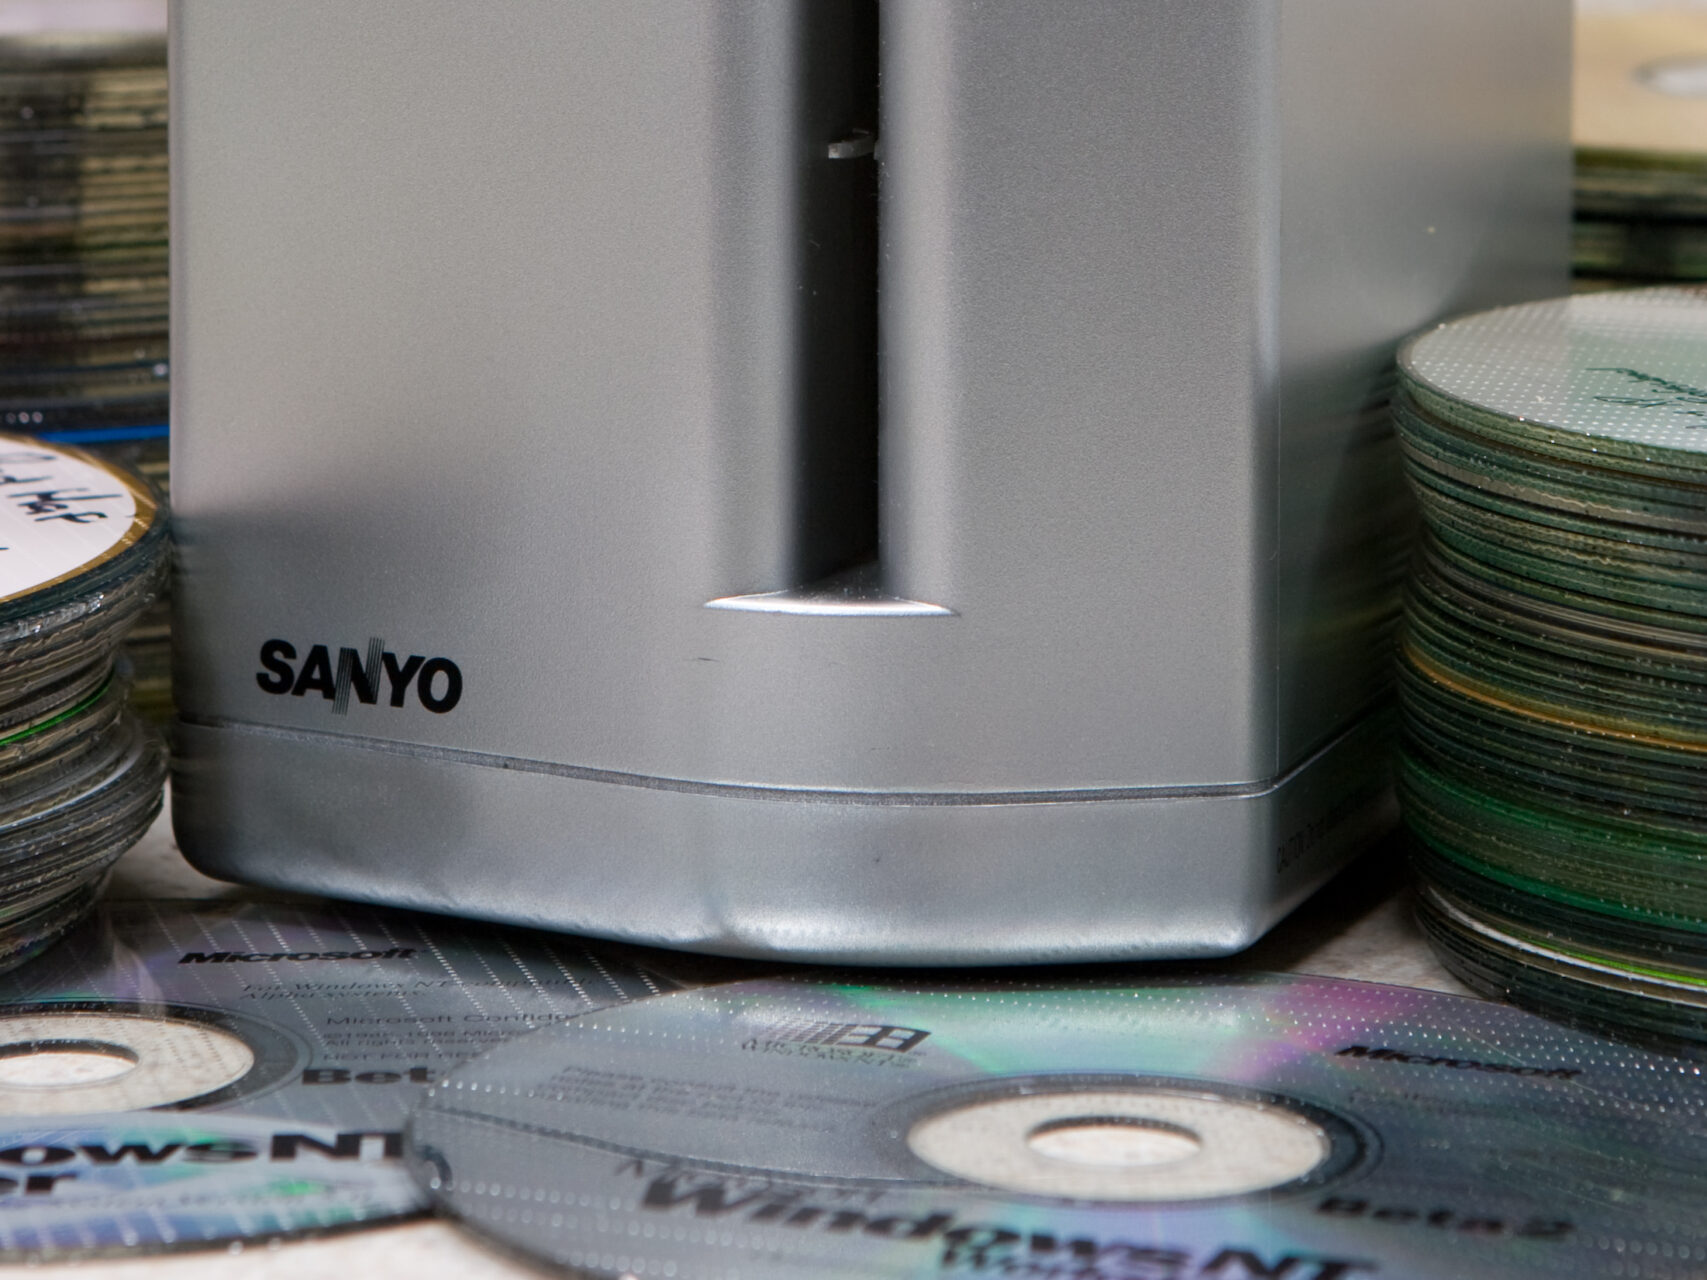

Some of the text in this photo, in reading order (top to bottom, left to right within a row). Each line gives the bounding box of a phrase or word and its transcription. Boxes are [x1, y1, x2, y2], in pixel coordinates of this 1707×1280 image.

[255, 635, 464, 716] SANYO
[178, 948, 418, 964] Microsoft
[294, 981, 406, 991] Windows
[326, 1015, 453, 1025] Microsoft
